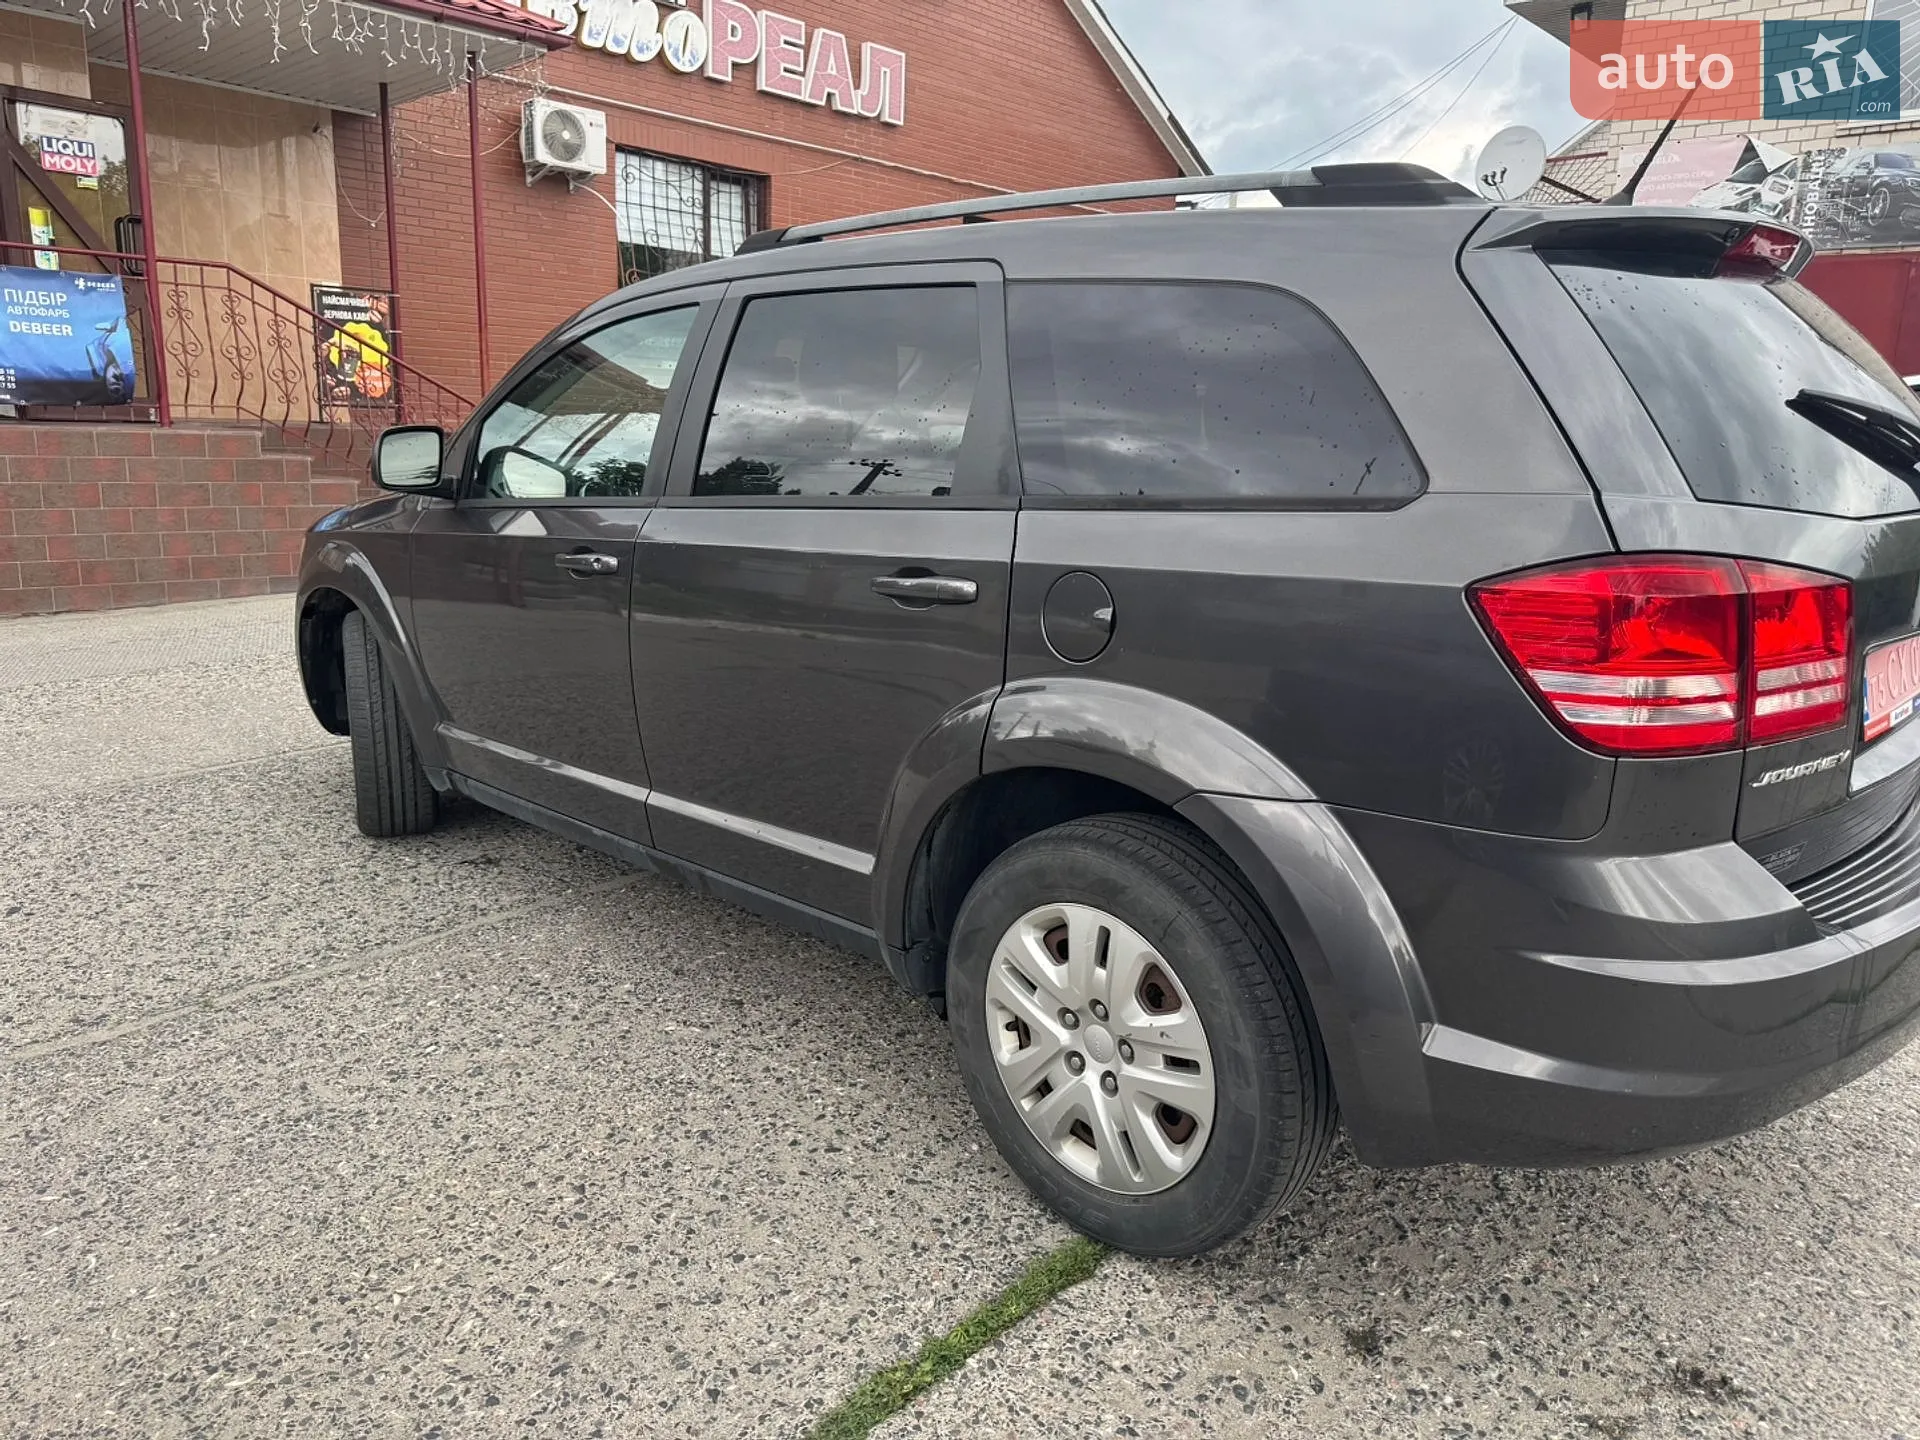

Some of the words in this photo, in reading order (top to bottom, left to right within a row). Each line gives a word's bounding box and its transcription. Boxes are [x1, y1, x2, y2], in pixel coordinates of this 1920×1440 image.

[42, 138, 94, 157] LIQUI
[44, 155, 97, 173] MOLY
[4, 288, 67, 306] ПІДБІР
[7, 306, 70, 318] АВТОФАРБ
[9, 321, 73, 336] DEBEER
[1751, 749, 1851, 787] JOURNEY
